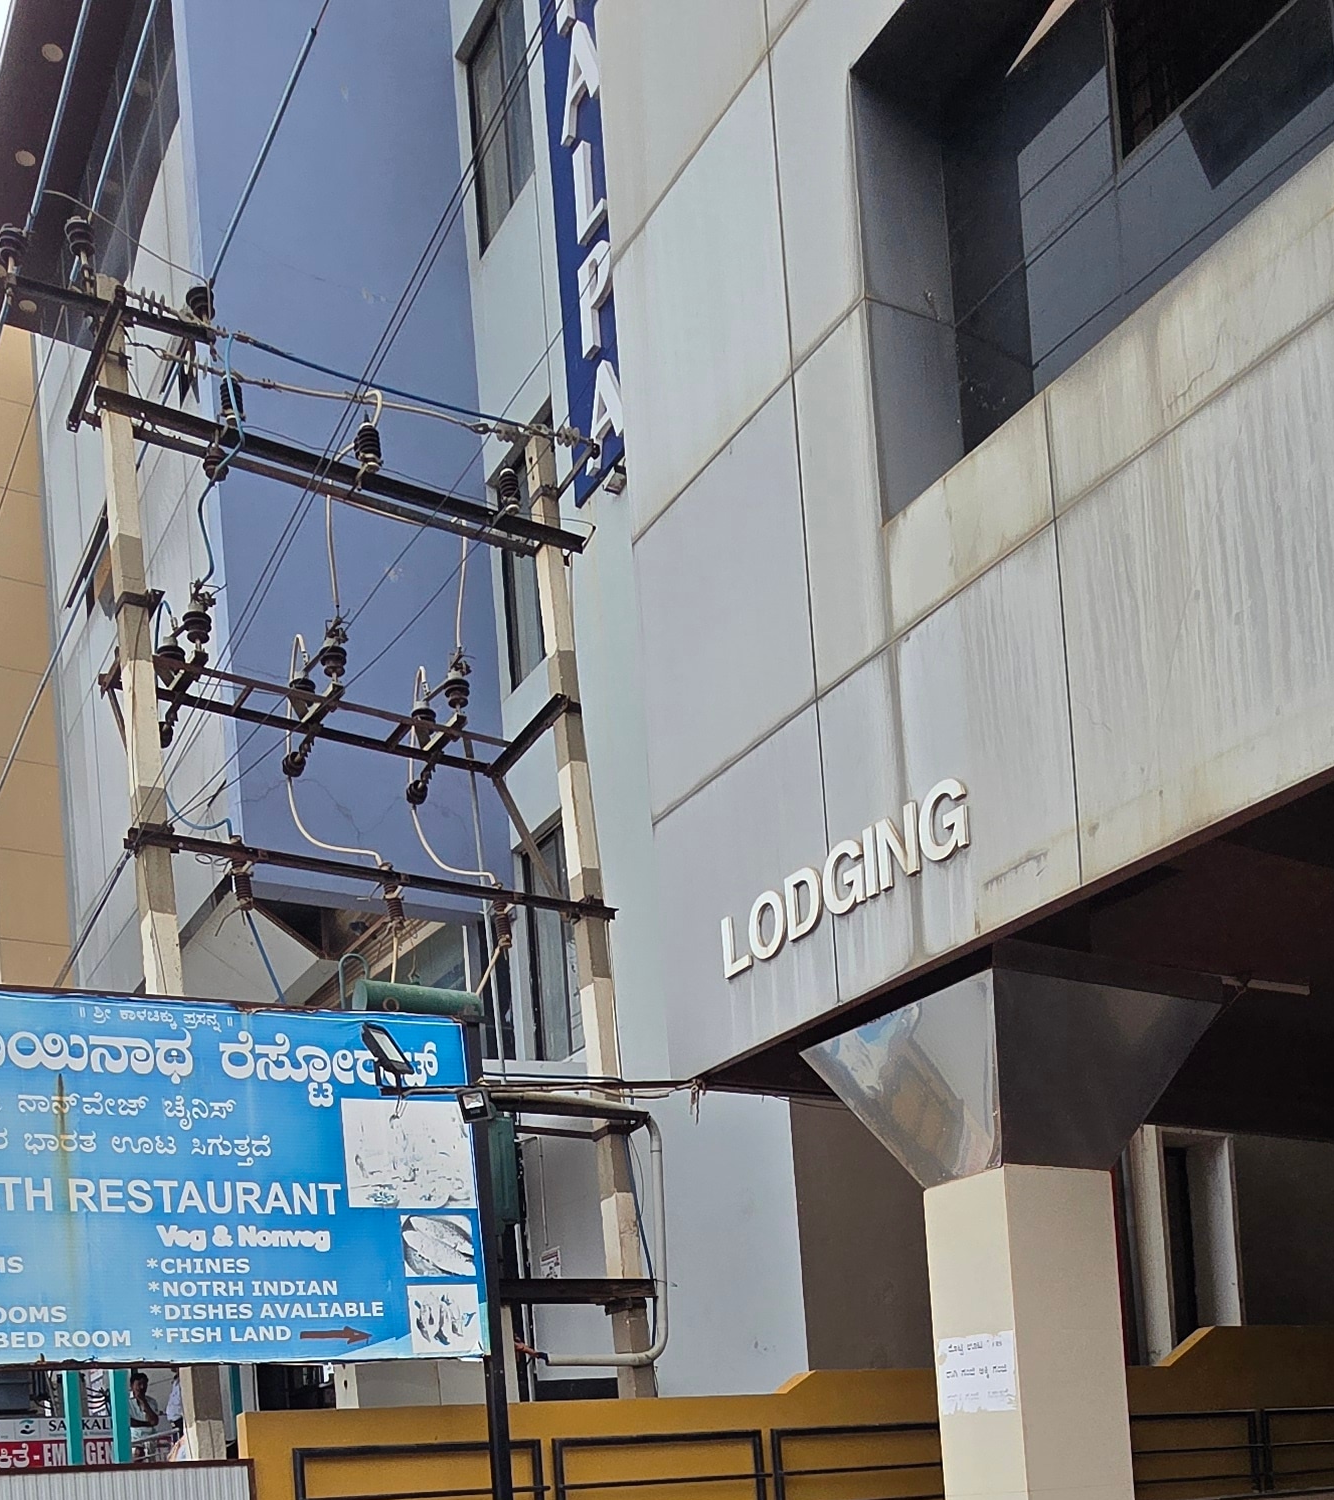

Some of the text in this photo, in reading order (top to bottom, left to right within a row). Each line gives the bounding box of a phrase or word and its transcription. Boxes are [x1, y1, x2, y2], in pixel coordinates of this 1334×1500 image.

[555, 0, 625, 478] ALPA
[721, 778, 970, 981] LODGING
[93, 1006, 111, 1023] ಶ್ರೀ
[183, 1011, 222, 1033] ಪ್ರಸನ್ನ
[163, 1095, 237, 1131] ಚೈನಿಸ್
[23, 1129, 97, 1155] ಭಾರತ
[111, 1135, 177, 1155] ಊಟ
[190, 1134, 272, 1167] ಸಿಗುತ್ತದೆ
[69, 1178, 342, 1216] RESTAURANT
[155, 1224, 331, 1253] Veg & Nonveg
[252, 1280, 338, 1297] INDIAN
[260, 1301, 384, 1319] AVALIABLE
[55, 1330, 131, 1349] ROOM
[230, 1325, 291, 1343] LAND
